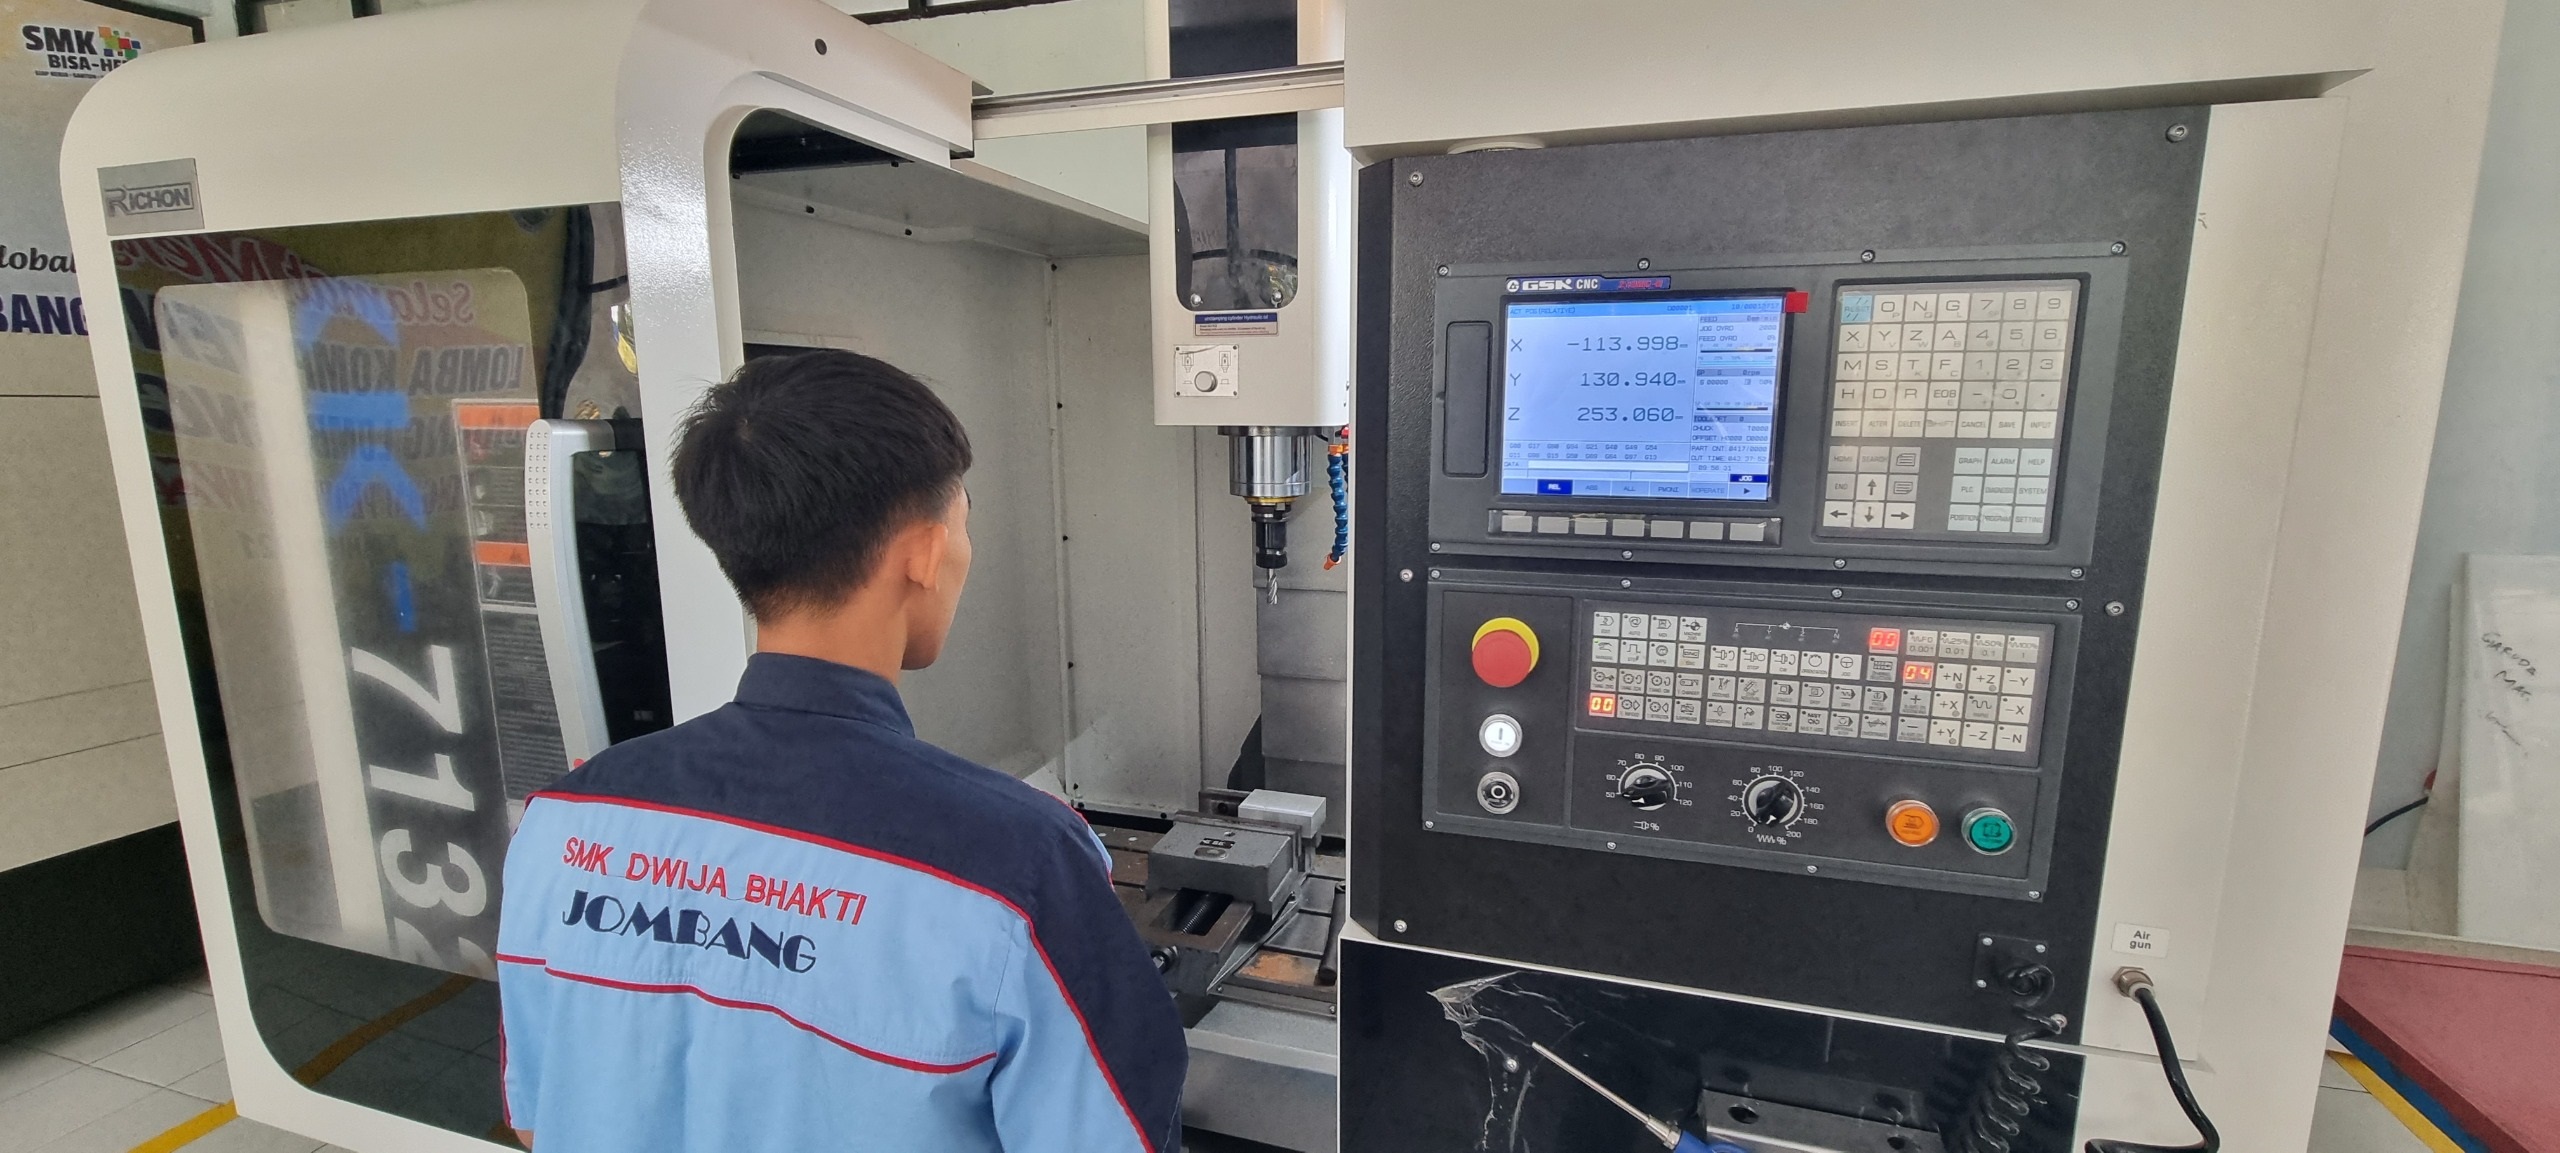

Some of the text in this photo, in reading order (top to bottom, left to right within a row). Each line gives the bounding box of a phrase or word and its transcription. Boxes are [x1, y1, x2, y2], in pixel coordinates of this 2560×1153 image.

[22, 25, 98, 55] SMK
[48, 54, 128, 72] BISA-HE
[105, 186, 190, 217] RICHON
[1522, 279, 1598, 291] GSK CNC
[1913, 301, 1928, 311] N
[1945, 300, 1960, 311] G
[1980, 299, 1994, 310] 7
[2013, 298, 2026, 310] 8
[2047, 298, 2061, 309] 9
[1846, 331, 1859, 342] X
[1878, 331, 1891, 341] Y
[1910, 330, 1923, 341] Z
[1942, 330, 1956, 340] A
[1976, 329, 1989, 340] 4
[2009, 328, 2023, 340] 5
[2044, 328, 2058, 340] 6
[1510, 336, 1679, 352] X -113.998
[1844, 360, 1862, 371] M
[1875, 360, 1889, 371] S
[1907, 359, 1920, 370] T
[1939, 359, 1952, 370] F
[1975, 359, 1983, 370] 1
[2006, 358, 2020, 370] 2
[2039, 358, 2054, 370] 3
[1510, 372, 1677, 387] Y 130.940
[1841, 388, 1855, 399] H
[1872, 388, 1887, 399] D
[1904, 388, 1918, 399] R
[1933, 389, 1957, 399] EOB
[1507, 407, 1674, 422] Z 253.060
[1897, 420, 1921, 428] DELETE
[1998, 421, 2016, 429] SAVE
[2030, 421, 2052, 429] INPUT
[2028, 458, 2046, 466] HELP
[2019, 487, 2047, 495] SYSTEM
[1871, 631, 1897, 647] 00
[1945, 647, 1965, 655] 0.01
[1982, 649, 1996, 657] 0.1
[1905, 665, 1931, 680] 04
[1943, 672, 1963, 682] +N
[1976, 674, 1996, 685] +Z
[1591, 696, 1613, 712] 00
[1939, 700, 1958, 710] +X
[1937, 728, 1955, 738] +Y
[1670, 764, 1685, 772] 100
[1789, 770, 1804, 778] 120
[1679, 781, 1693, 789] 110
[1805, 786, 1821, 794] 140
[1650, 822, 1660, 831] %
[1786, 830, 1802, 838] 200
[1776, 836, 1787, 845] %
[563, 836, 867, 925] SMK DWIJA BHAKTI
[562, 889, 816, 973] JOMBANG
[2133, 930, 2151, 940] Air
[2129, 941, 2151, 949] gun
